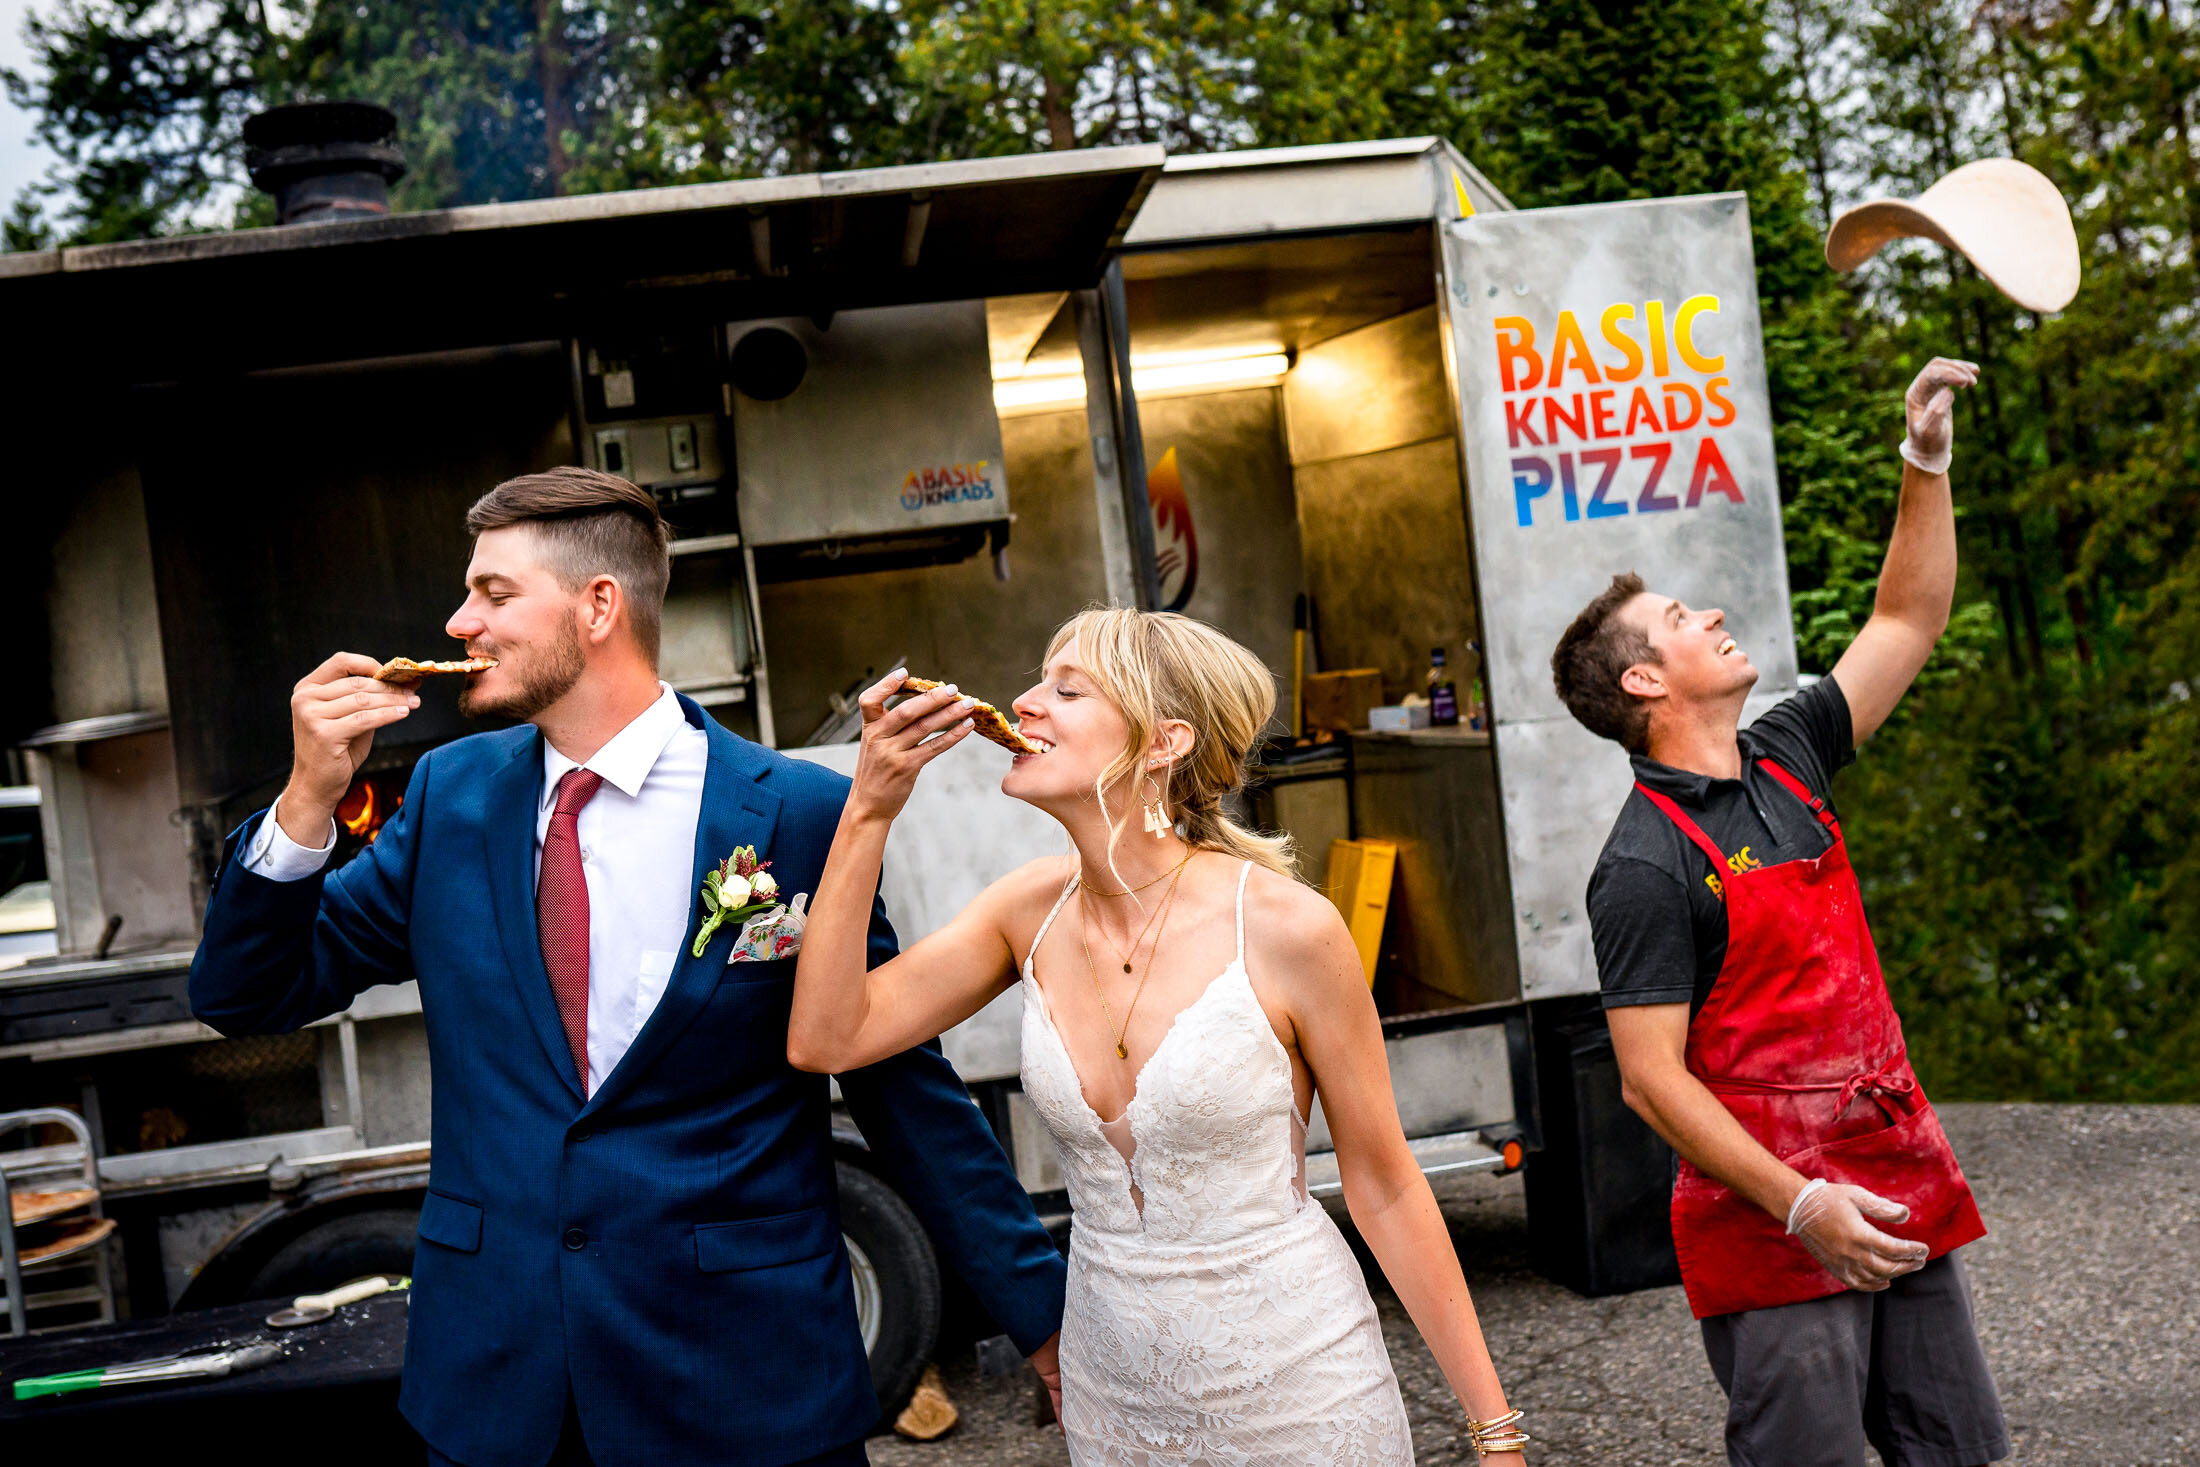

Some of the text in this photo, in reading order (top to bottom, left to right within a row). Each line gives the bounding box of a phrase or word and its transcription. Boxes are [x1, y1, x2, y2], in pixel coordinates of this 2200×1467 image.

[1494, 295, 1725, 392] BASIC
[1505, 377, 1736, 448] KNEADS
[922, 461, 988, 488] BASIC
[926, 479, 994, 506] KNEADS
[1511, 437, 1745, 527] PIZZA
[1705, 846, 1759, 895] BSIC
